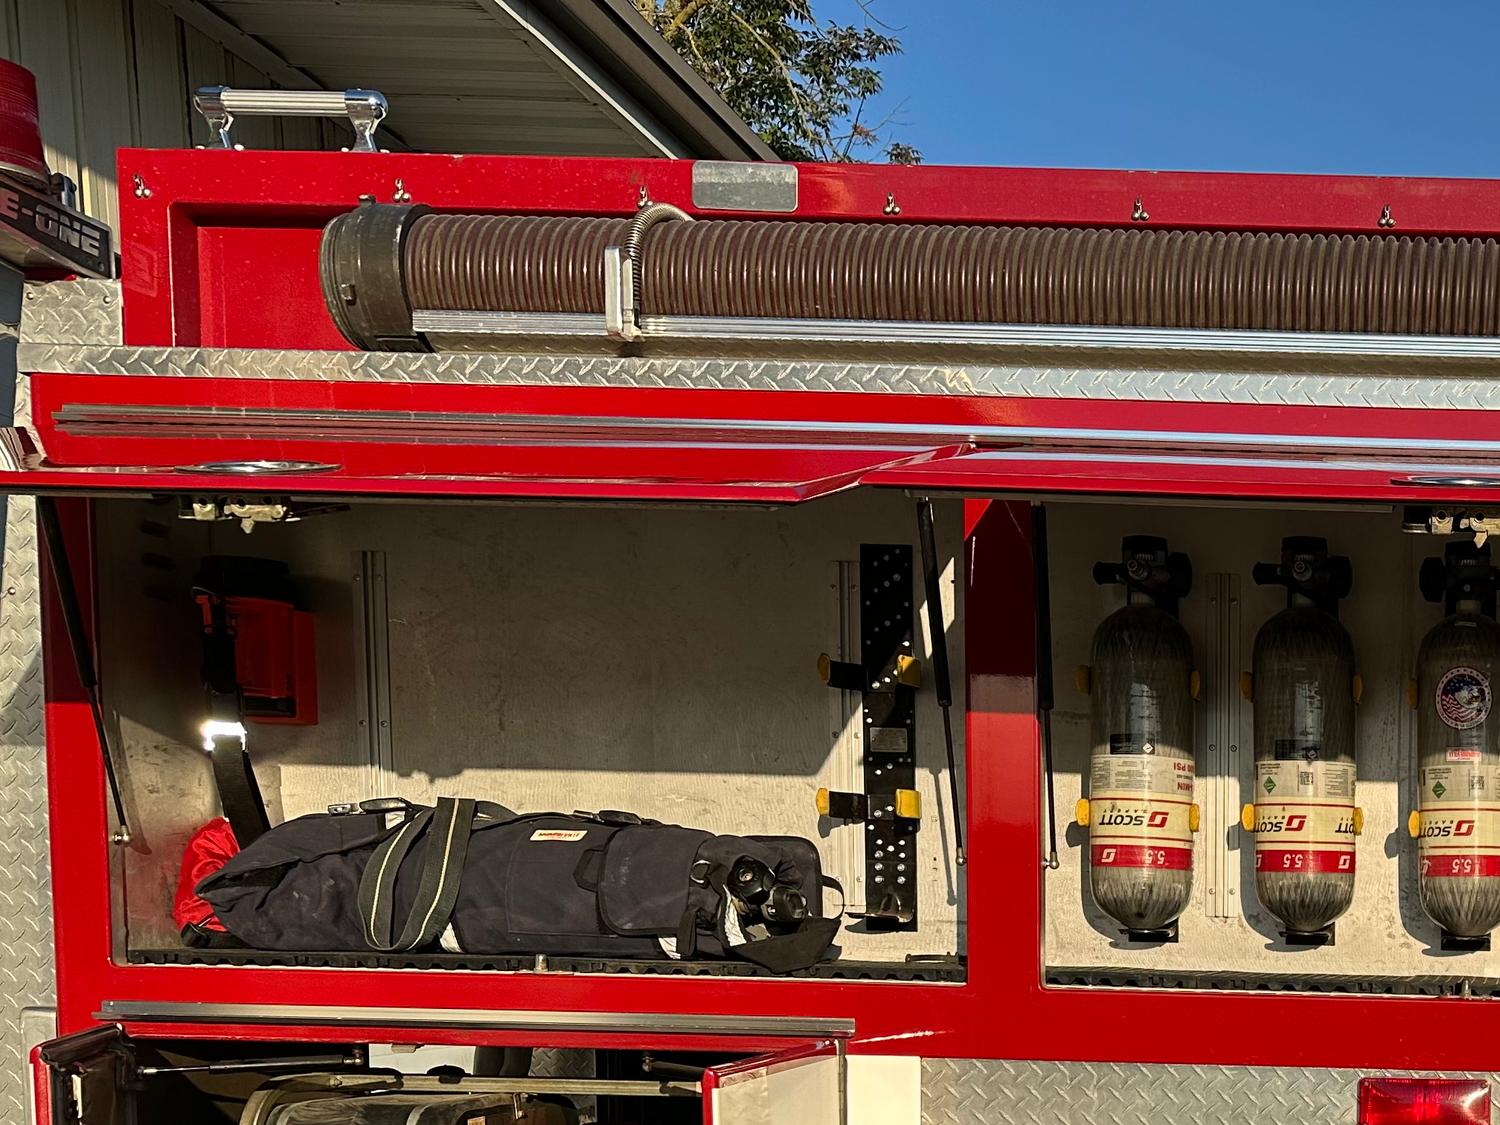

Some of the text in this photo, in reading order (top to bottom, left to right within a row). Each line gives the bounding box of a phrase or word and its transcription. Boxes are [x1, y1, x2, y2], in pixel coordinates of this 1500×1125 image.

[1099, 814, 1145, 826] SCOTT
[1144, 849, 1166, 865] 5.5
[1283, 853, 1304, 868] 5.5
[1451, 858, 1472, 874] 5.5
